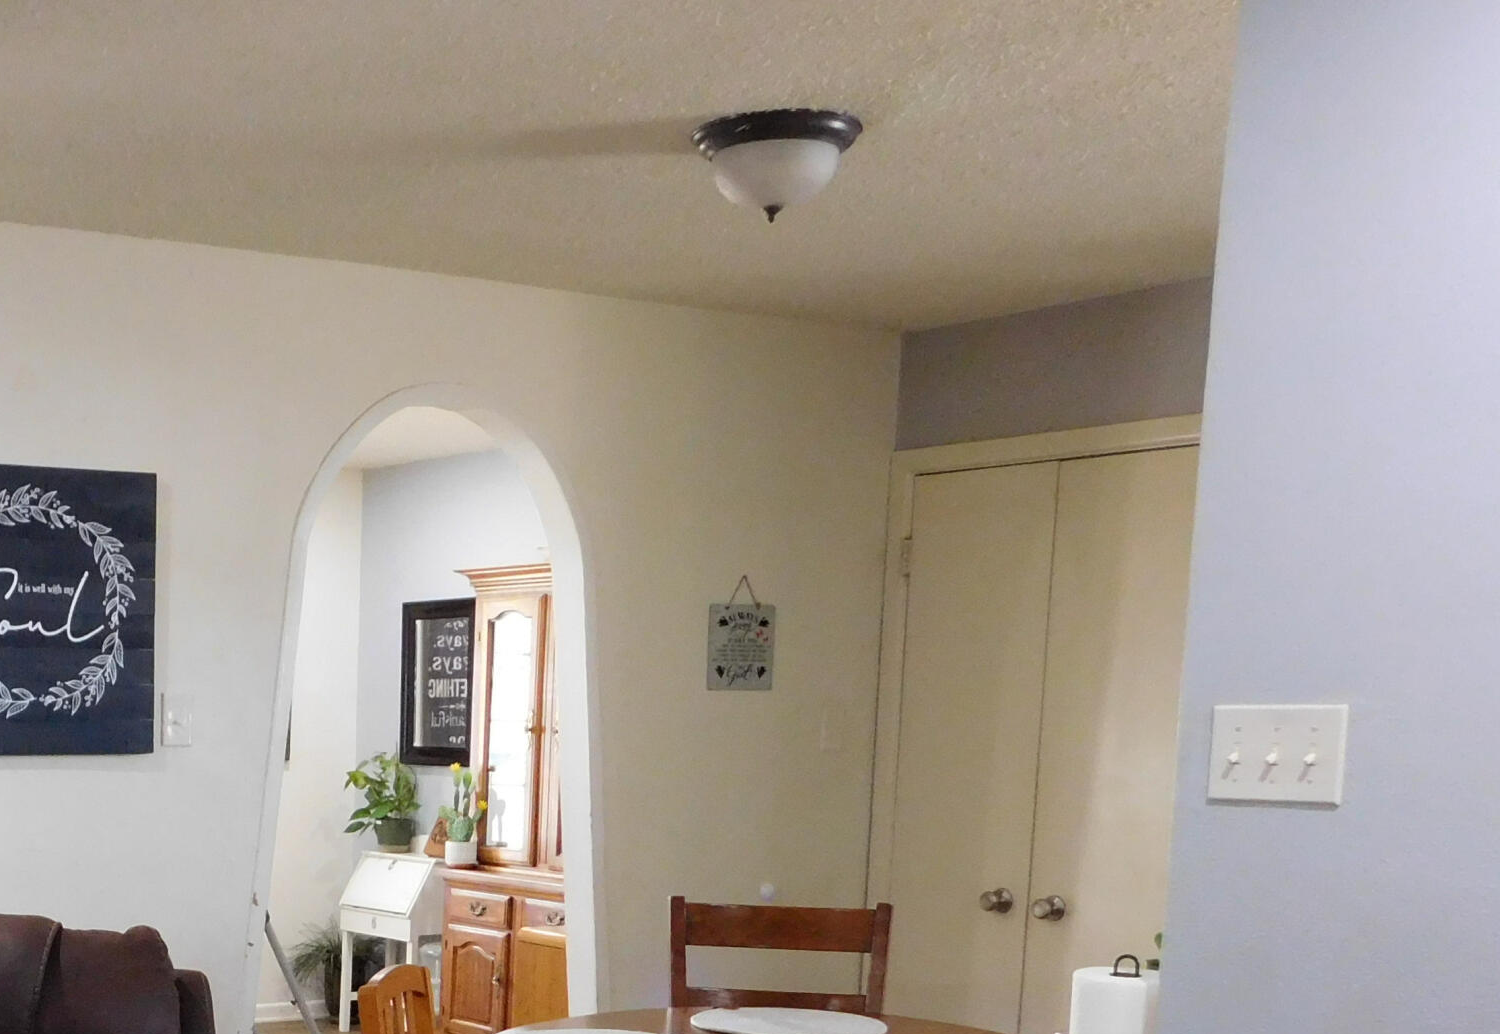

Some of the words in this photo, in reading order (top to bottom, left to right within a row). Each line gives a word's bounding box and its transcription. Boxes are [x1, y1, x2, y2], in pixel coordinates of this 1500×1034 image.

[17, 582, 23, 593] it
[24, 583, 31, 593] is
[32, 583, 46, 593] well
[47, 584, 63, 595] with
[64, 587, 75, 597] my
